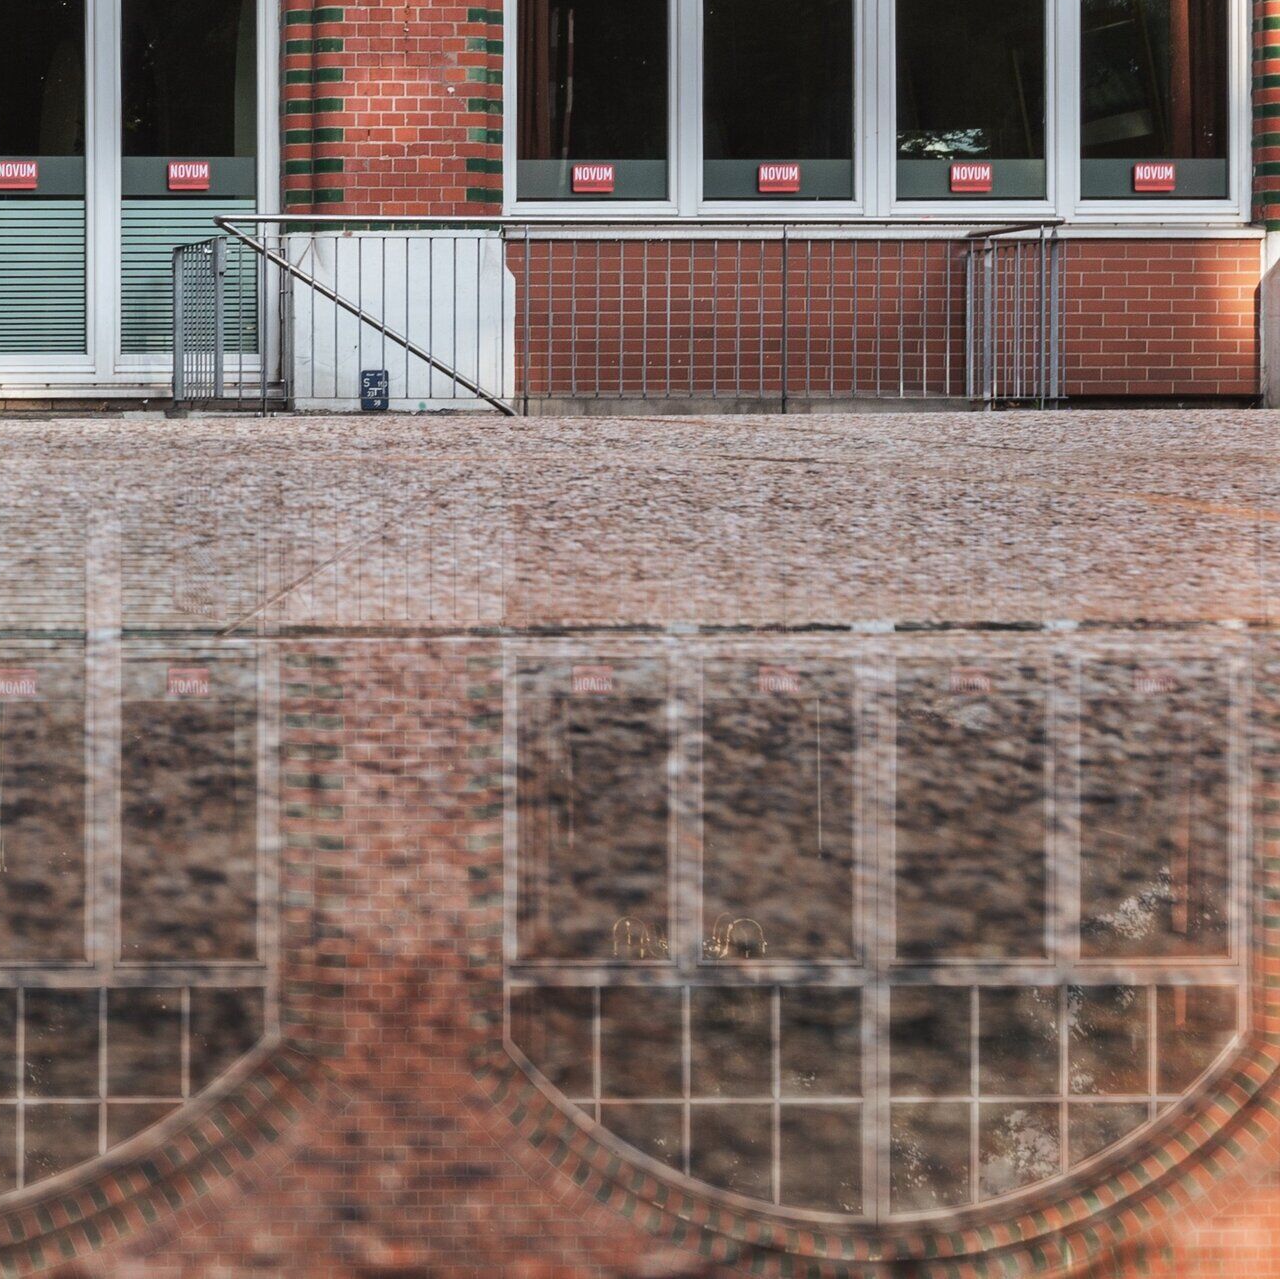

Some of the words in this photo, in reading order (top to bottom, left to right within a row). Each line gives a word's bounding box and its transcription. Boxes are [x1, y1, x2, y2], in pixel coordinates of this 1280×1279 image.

[170, 163, 209, 178] NOVUM
[574, 167, 613, 181] NOVUM
[760, 167, 799, 181] NOVUM
[952, 166, 990, 180] NOVUM
[1135, 166, 1174, 180] NOVUM
[363, 378, 371, 388] S
